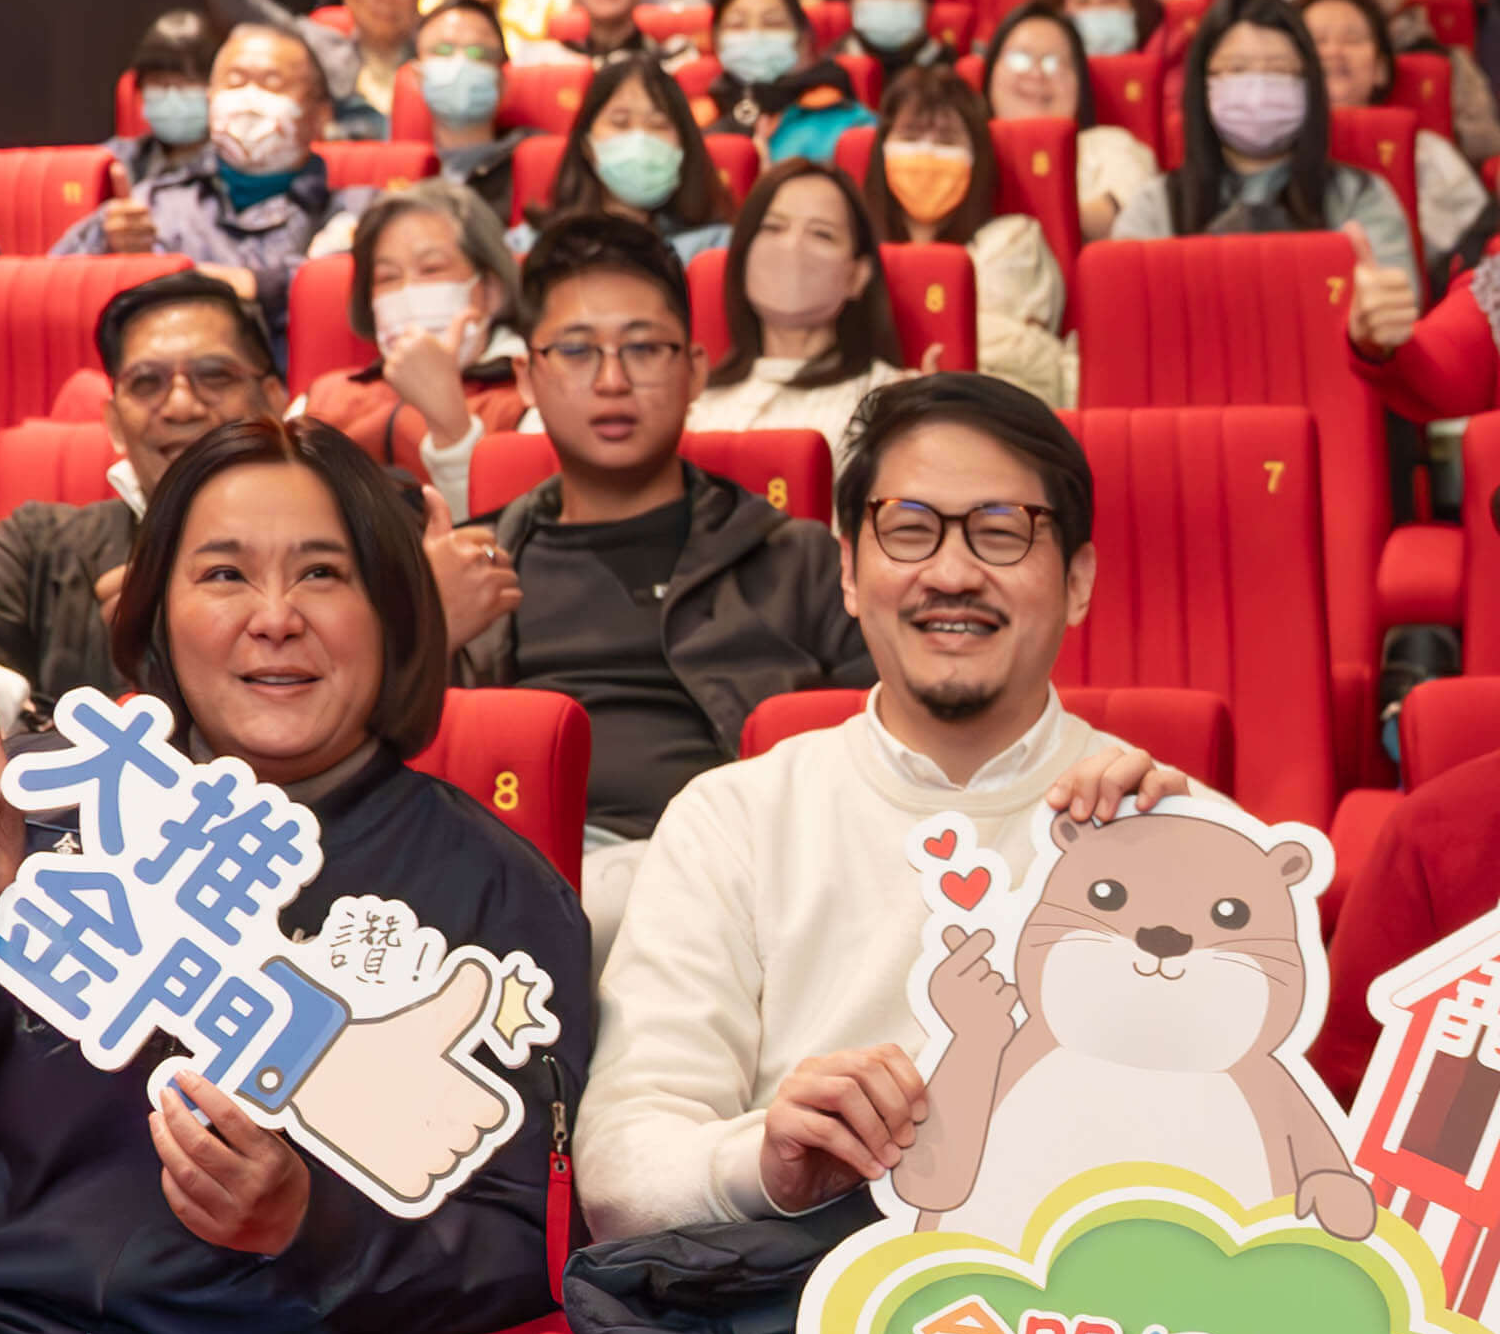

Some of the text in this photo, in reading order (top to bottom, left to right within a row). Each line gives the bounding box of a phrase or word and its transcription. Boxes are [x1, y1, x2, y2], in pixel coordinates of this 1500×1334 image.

[767, 478, 788, 509] 8
[1263, 460, 1288, 493] 7
[493, 771, 517, 810] 8
[19, 702, 303, 946] 大推
